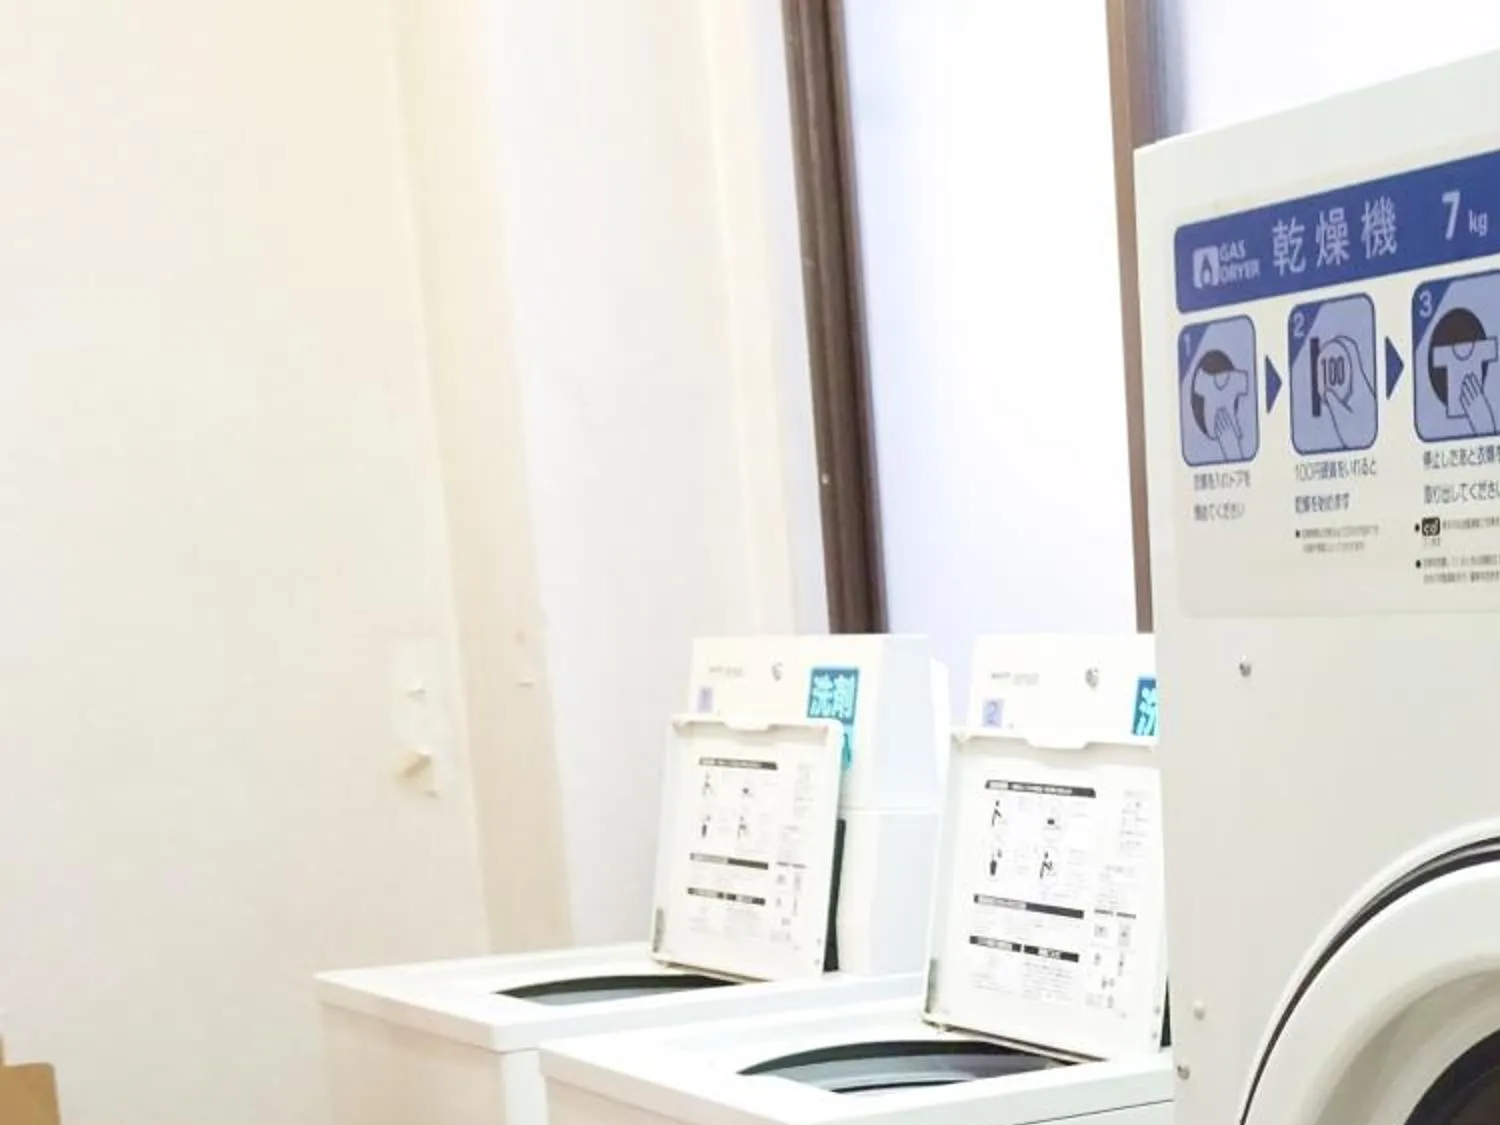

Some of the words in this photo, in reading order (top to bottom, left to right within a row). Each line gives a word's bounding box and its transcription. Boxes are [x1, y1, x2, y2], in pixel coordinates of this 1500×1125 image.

[1442, 190, 1460, 240] 7
[1468, 210, 1488, 236] kg
[1272, 196, 1398, 276] 乾燥機
[1219, 240, 1246, 262] GAS
[1219, 260, 1261, 285] DRYER
[1419, 291, 1433, 317] 3
[1293, 314, 1306, 338] 2
[1321, 355, 1345, 387] 100
